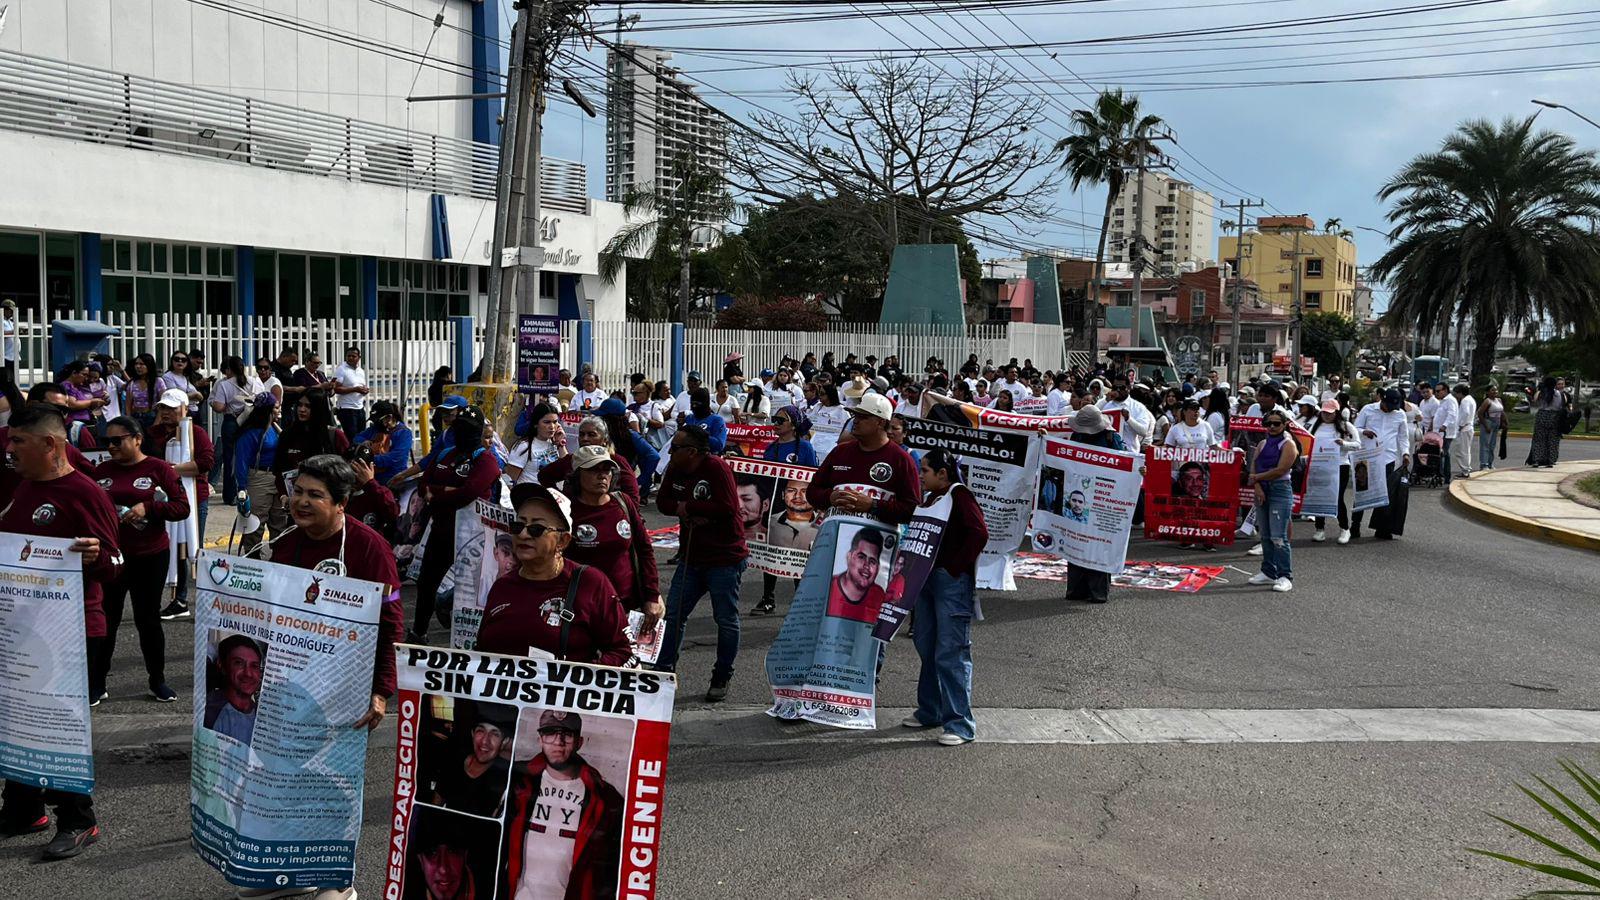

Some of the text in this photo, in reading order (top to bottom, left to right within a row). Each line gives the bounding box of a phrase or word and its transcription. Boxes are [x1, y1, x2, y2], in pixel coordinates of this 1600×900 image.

[908, 421, 1004, 443] ¡AYUDAME A
[908, 434, 1015, 459] NCONTRARLO!
[1057, 447, 1120, 466] ¡SE BUSCA!
[1153, 446, 1235, 465] DESAPARECIDO
[729, 460, 811, 481] DESAPARECI
[972, 472, 1001, 483] KEVIN
[971, 482, 997, 492] CRUZ
[1094, 489, 1111, 497] CRUZ
[1095, 481, 1115, 490] KEVIN
[919, 531, 930, 542] ES
[1158, 525, 1221, 537] 6671571930
[33, 547, 63, 557] SINALOA
[56, 577, 65, 587] a
[229, 575, 262, 592] Sinaloa
[0, 586, 71, 601] ANCHEZ IBARRA
[323, 588, 364, 603] SINALOA
[267, 613, 273, 624] a
[275, 614, 344, 640] encontrar
[347, 629, 359, 642] a
[218, 617, 336, 656] JUAN LUIS IRIBE RODRÍGUEZ
[407, 647, 661, 694] POR LAS VOCES
[423, 669, 637, 716] SIN JUSTICIA
[801, 690, 839, 702] EGRESAR
[846, 699, 872, 707] CASA!
[35, 753, 51, 762] esta
[385, 699, 416, 900] DESAPARECIDO
[626, 758, 663, 900] RGENTE
[276, 845, 300, 853] esta
[247, 855, 259, 864] es
[262, 855, 287, 866] muy
[289, 855, 351, 865] importante.
